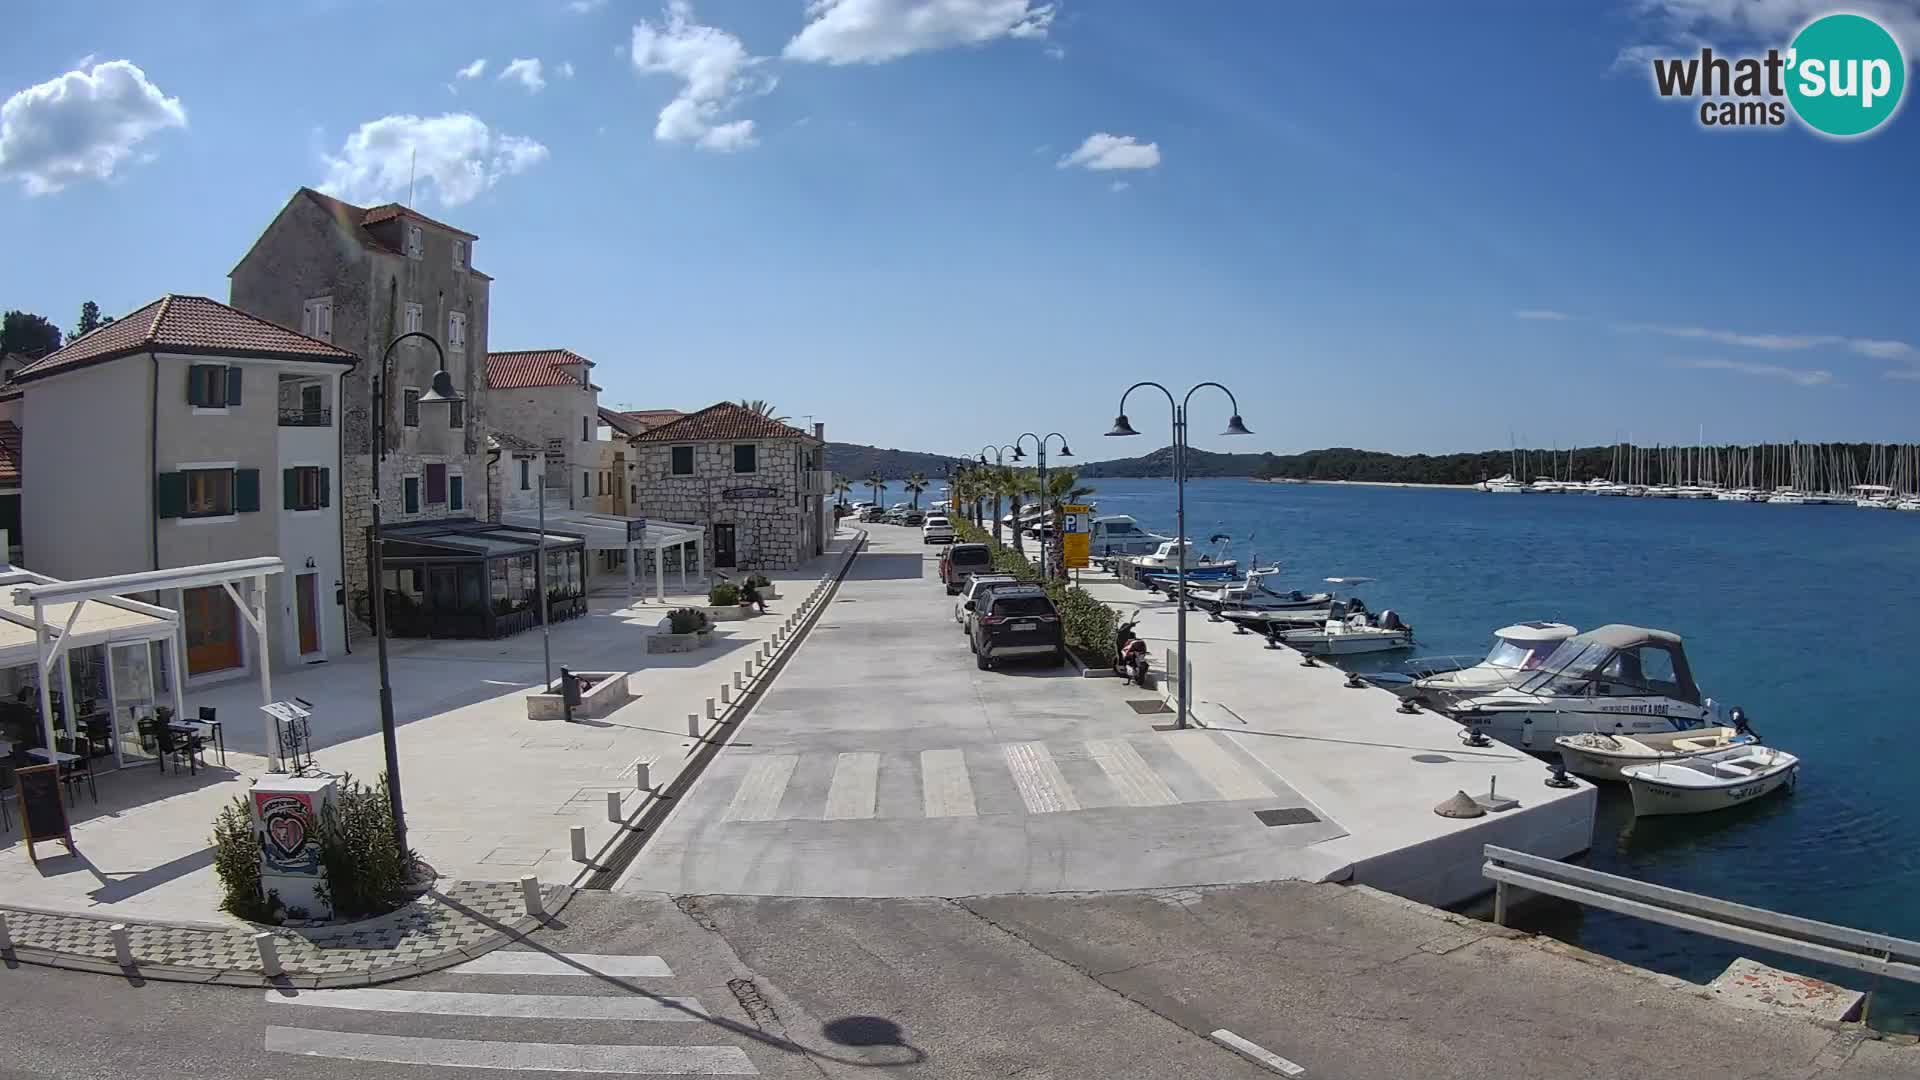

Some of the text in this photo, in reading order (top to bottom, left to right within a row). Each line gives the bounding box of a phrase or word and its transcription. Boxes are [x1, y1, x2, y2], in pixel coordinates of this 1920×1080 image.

[1066, 515, 1076, 531] P
[1630, 704, 1647, 713] RENT
[1654, 704, 1669, 715] BOAT
